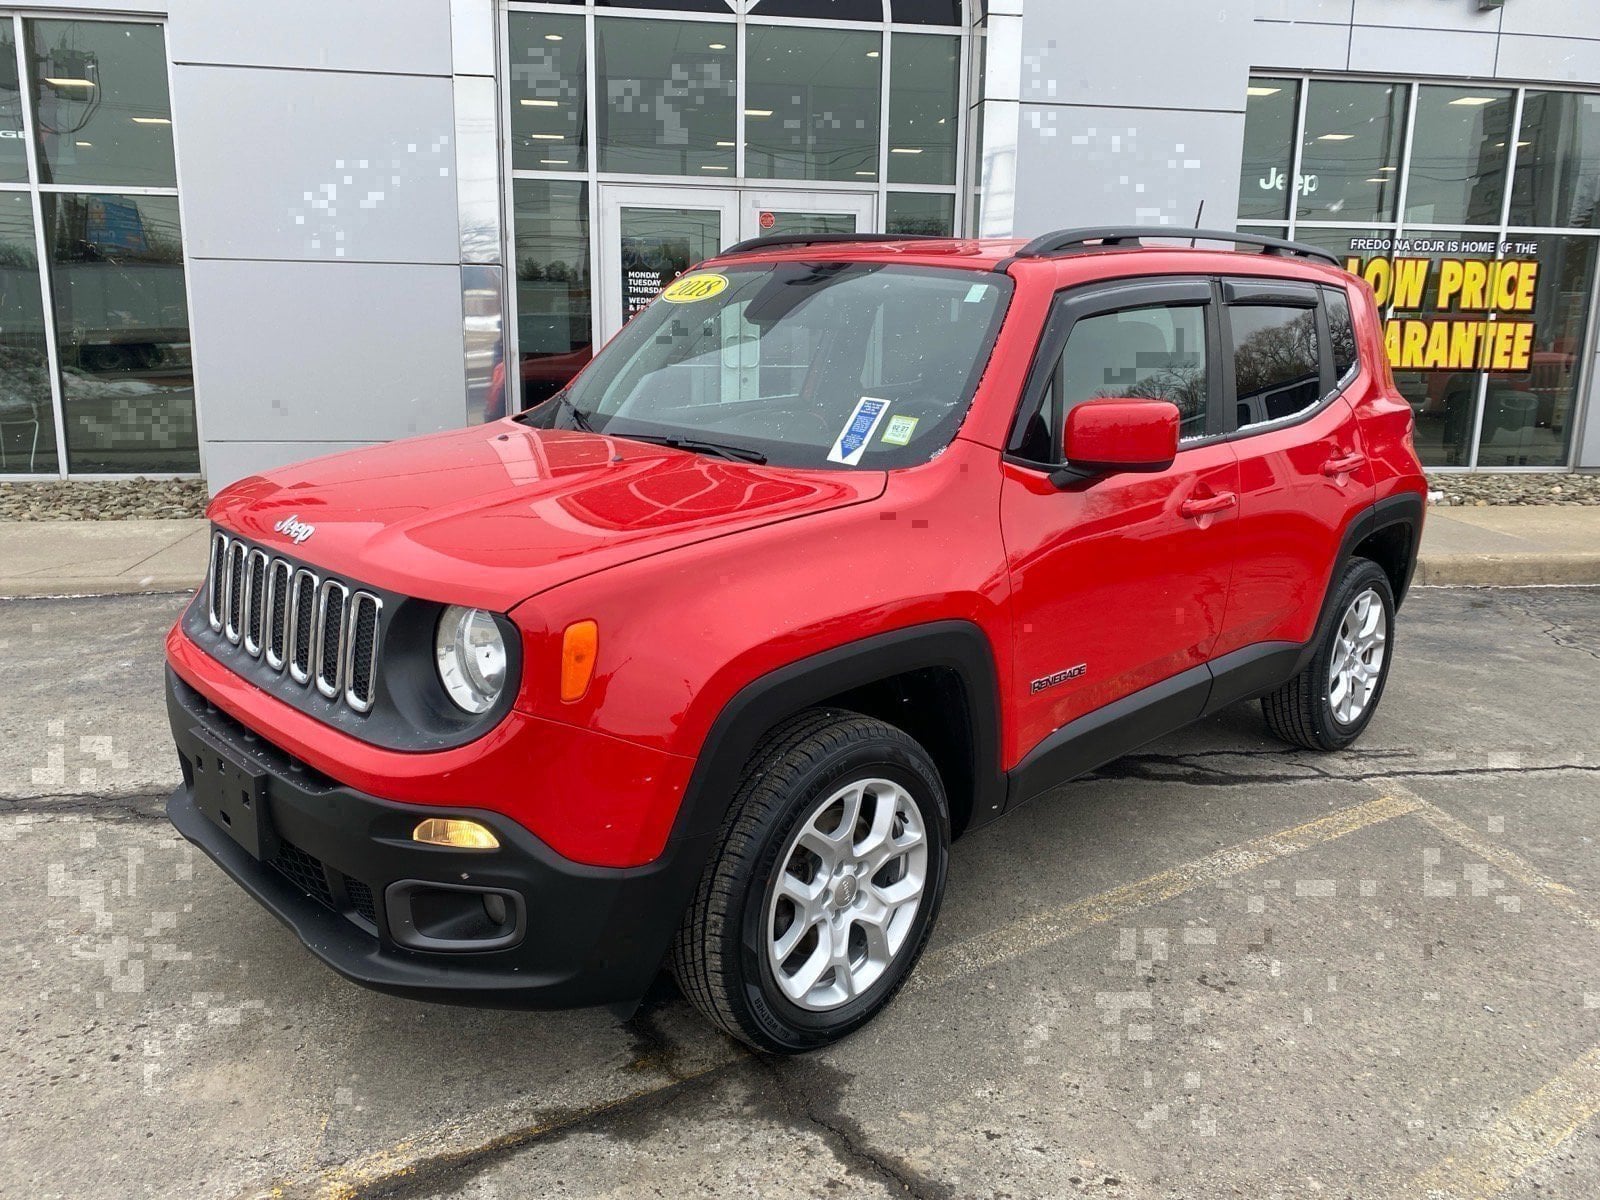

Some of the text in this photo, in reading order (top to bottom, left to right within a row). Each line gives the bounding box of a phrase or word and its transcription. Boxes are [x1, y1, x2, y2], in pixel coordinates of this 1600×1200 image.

[1259, 167, 1319, 196] Jeep
[1350, 239, 1411, 250] FREDONA
[1413, 240, 1445, 252] CDJR
[1447, 241, 1459, 252] IS
[1461, 241, 1496, 253] HOME
[1515, 243, 1538, 254] THE
[628, 271, 660, 279] MONDAY
[628, 279, 662, 287] TUESDAY
[628, 286, 665, 294] THURSDA
[1437, 260, 1539, 311] PRICE
[1384, 320, 1535, 369] ARANTEE
[273, 514, 316, 545] Jeep
[1030, 663, 1087, 695] RENEGADE
[753, 997, 779, 1031] WEATHER
